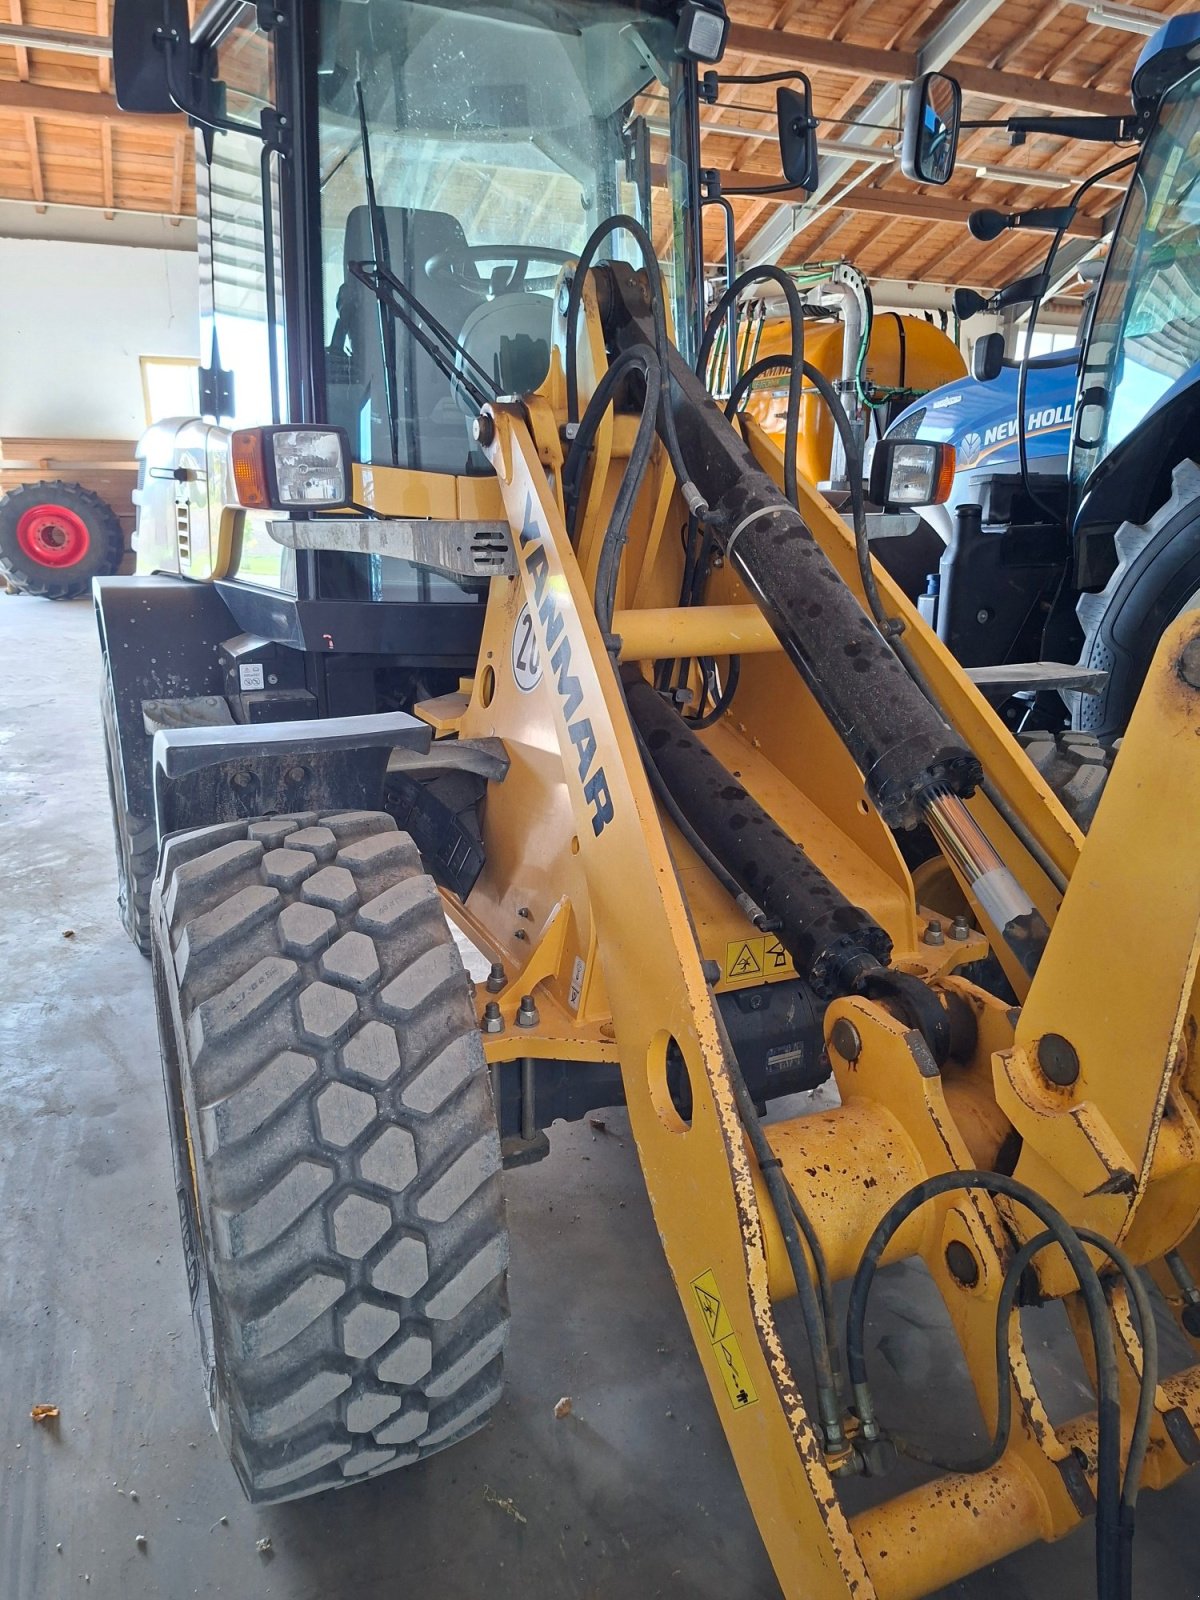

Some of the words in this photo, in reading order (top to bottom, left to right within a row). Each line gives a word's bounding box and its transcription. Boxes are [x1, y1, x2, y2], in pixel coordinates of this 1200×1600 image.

[984, 419, 1019, 446] NEW
[1027, 404, 1073, 431] HOLL
[519, 490, 615, 838] YANMAR
